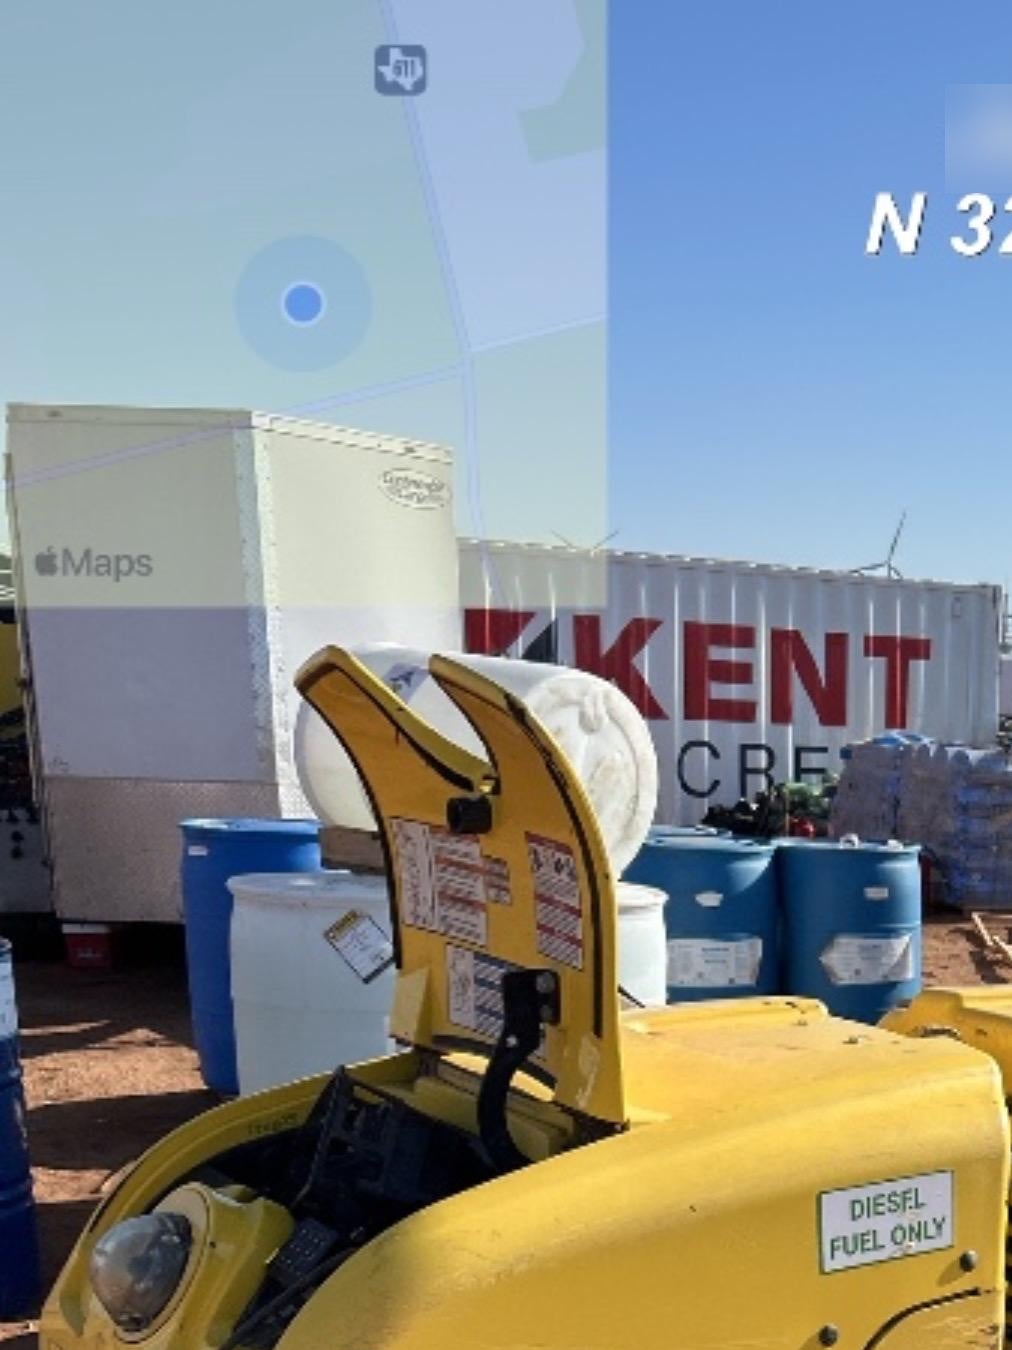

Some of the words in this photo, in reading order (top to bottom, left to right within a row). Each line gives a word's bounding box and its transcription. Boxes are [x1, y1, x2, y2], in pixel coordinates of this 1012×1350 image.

[572, 614, 932, 730] KENT
[850, 1187, 928, 1222] DIESEL
[830, 1229, 886, 1261] FUEL
[890, 1216, 946, 1247] ONLY
